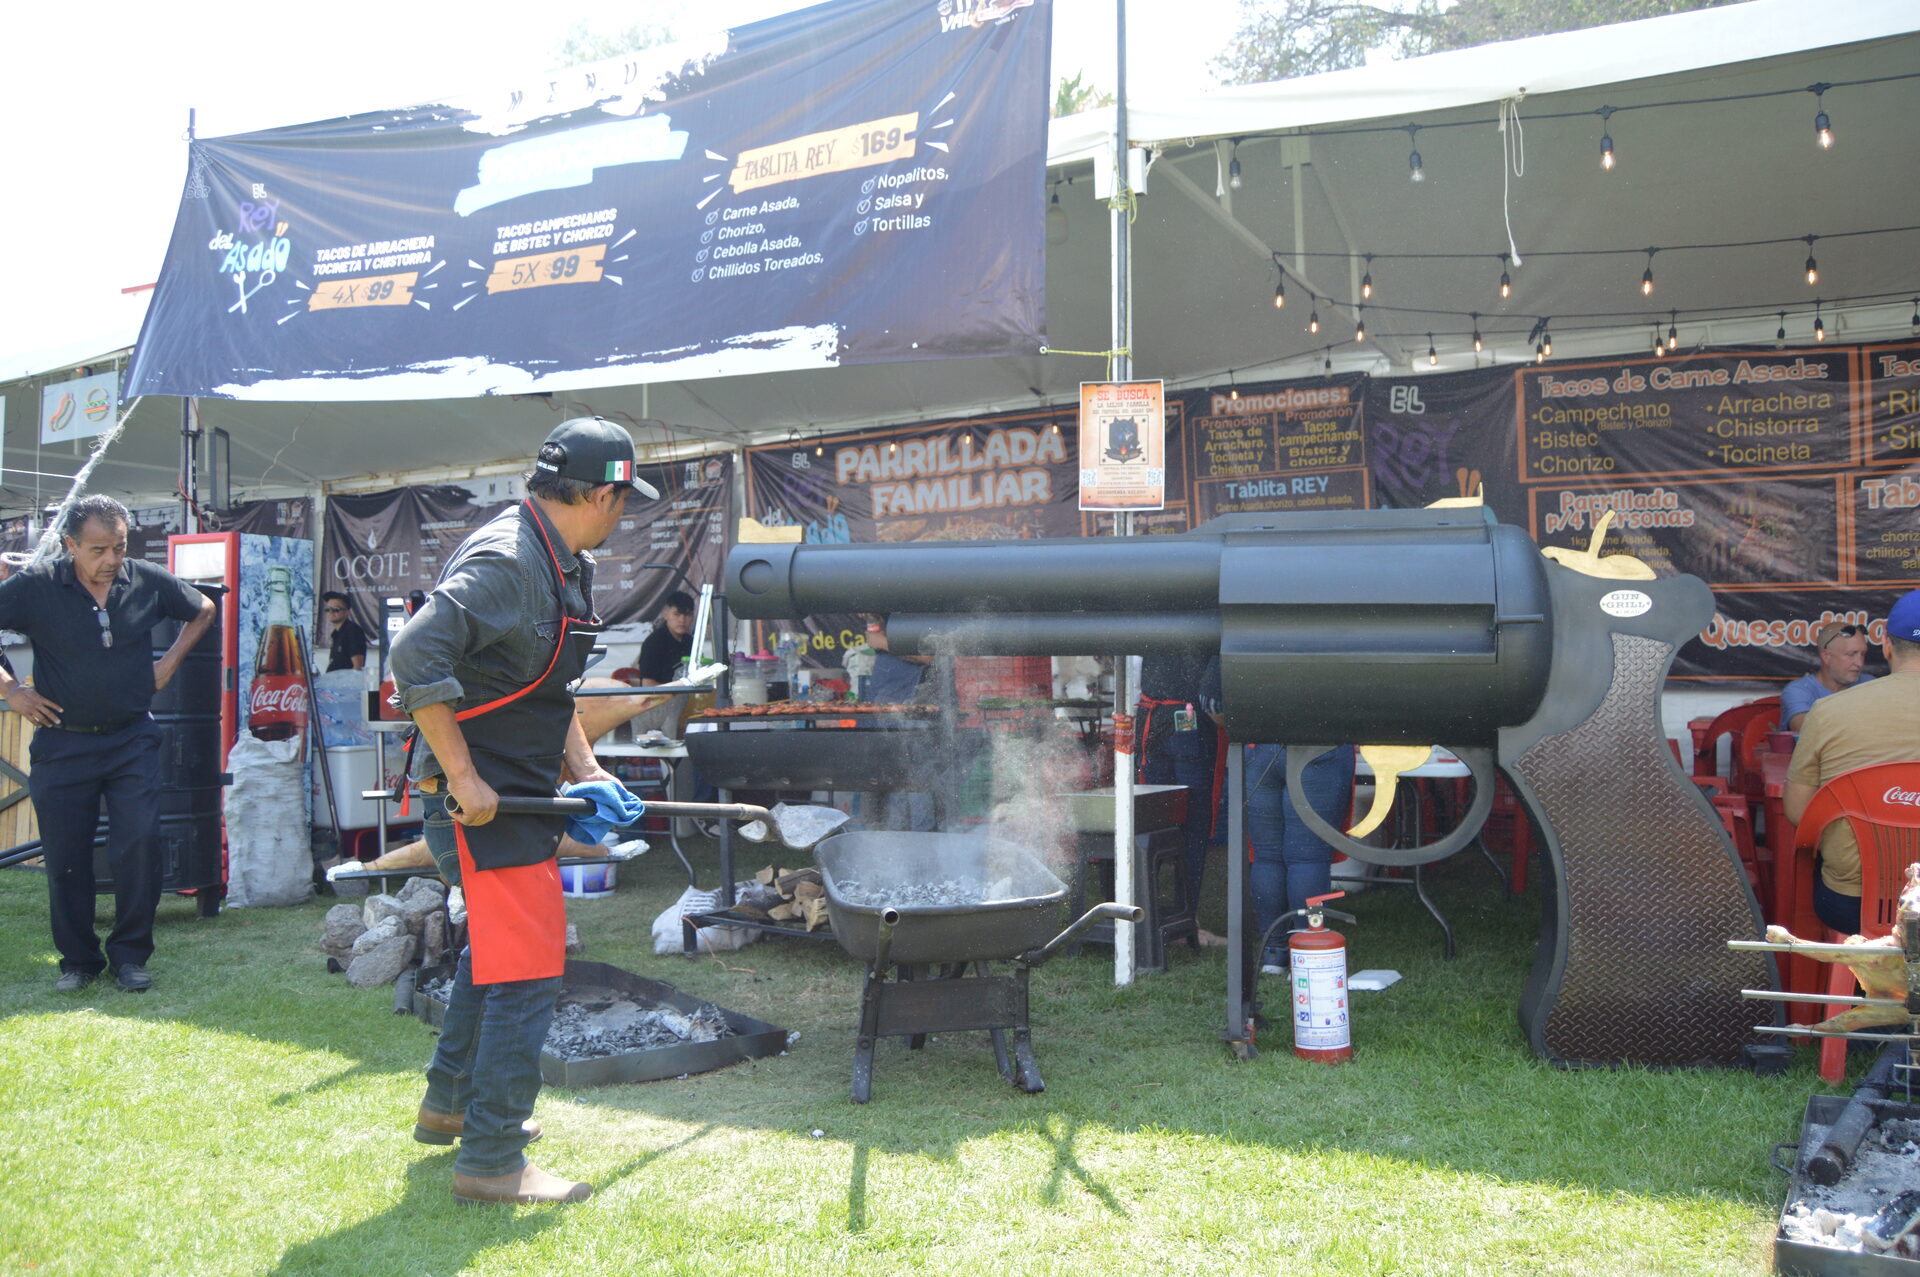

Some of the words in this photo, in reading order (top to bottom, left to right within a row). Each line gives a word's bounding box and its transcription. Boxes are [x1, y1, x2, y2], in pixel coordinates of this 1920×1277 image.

[744, 150, 799, 181] TABLITA
[804, 139, 838, 170] REY
[851, 127, 902, 157] $169
[877, 167, 949, 190] Nopalitos,
[722, 205, 758, 222] Carne
[759, 196, 800, 216] Asada,
[874, 193, 912, 211] Salsa
[914, 193, 925, 208] y
[496, 223, 532, 240] TACOS
[533, 208, 618, 233] CAMPECHANOS
[717, 222, 766, 240] Chorizo,
[872, 214, 931, 232] Tortillas
[316, 246, 351, 262] TACOS
[351, 243, 367, 259] DE
[367, 235, 435, 254] ARRACHERA
[493, 242, 509, 255] DE
[509, 234, 551, 253] BISTEC
[552, 232, 562, 245] Y
[562, 223, 614, 244] CHORIZO
[713, 242, 758, 260] Cebolla
[759, 235, 802, 252] Asada,
[313, 258, 362, 276] TOCINETA
[363, 257, 373, 271] Y
[372, 250, 432, 270] CHISTORRA
[511, 260, 541, 285] 5X
[543, 255, 580, 280] $99
[708, 262, 760, 280] Chillidos
[764, 252, 824, 272] Toreados,
[332, 284, 360, 304] 4X
[1538, 376, 1610, 398] Tacos
[1613, 369, 1647, 393] de
[1650, 365, 1729, 390] Carne
[1732, 358, 1830, 384] Asada:
[1097, 391, 1109, 400] SE
[1117, 389, 1150, 400] BUSCA
[1212, 387, 1350, 415] Promociones:
[1390, 385, 1425, 414] EL
[1717, 391, 1831, 416] Arrachera
[1889, 388, 1920, 415] Ri
[1538, 401, 1671, 425] Campechano
[1208, 429, 1244, 440] Tacos
[1247, 426, 1262, 437] de
[1303, 421, 1337, 433] Tacos
[1716, 415, 1820, 438] Chistorra
[1279, 431, 1363, 447] campechanos,
[1540, 430, 1599, 449] Bistec
[792, 452, 811, 469] EL
[836, 424, 1067, 485] PARRILLADA
[1209, 452, 1254, 463] Tocineta
[1255, 452, 1263, 461] y
[1289, 446, 1337, 457] Bistec
[1341, 445, 1351, 455] y
[1289, 455, 1348, 467] chorizo
[1718, 442, 1811, 464] Tocineta
[1209, 464, 1259, 475] Chistorra
[1540, 454, 1615, 473] Chorizo
[872, 467, 1053, 520] FAMILIAR
[1225, 479, 1287, 499] Tablita
[1291, 476, 1329, 494] REY
[1560, 488, 1679, 513] Parrillada
[1545, 510, 1585, 533] p/4
[335, 552, 410, 579] OCOTE
[812, 631, 836, 650] de
[251, 684, 308, 714] Coca-Cola
